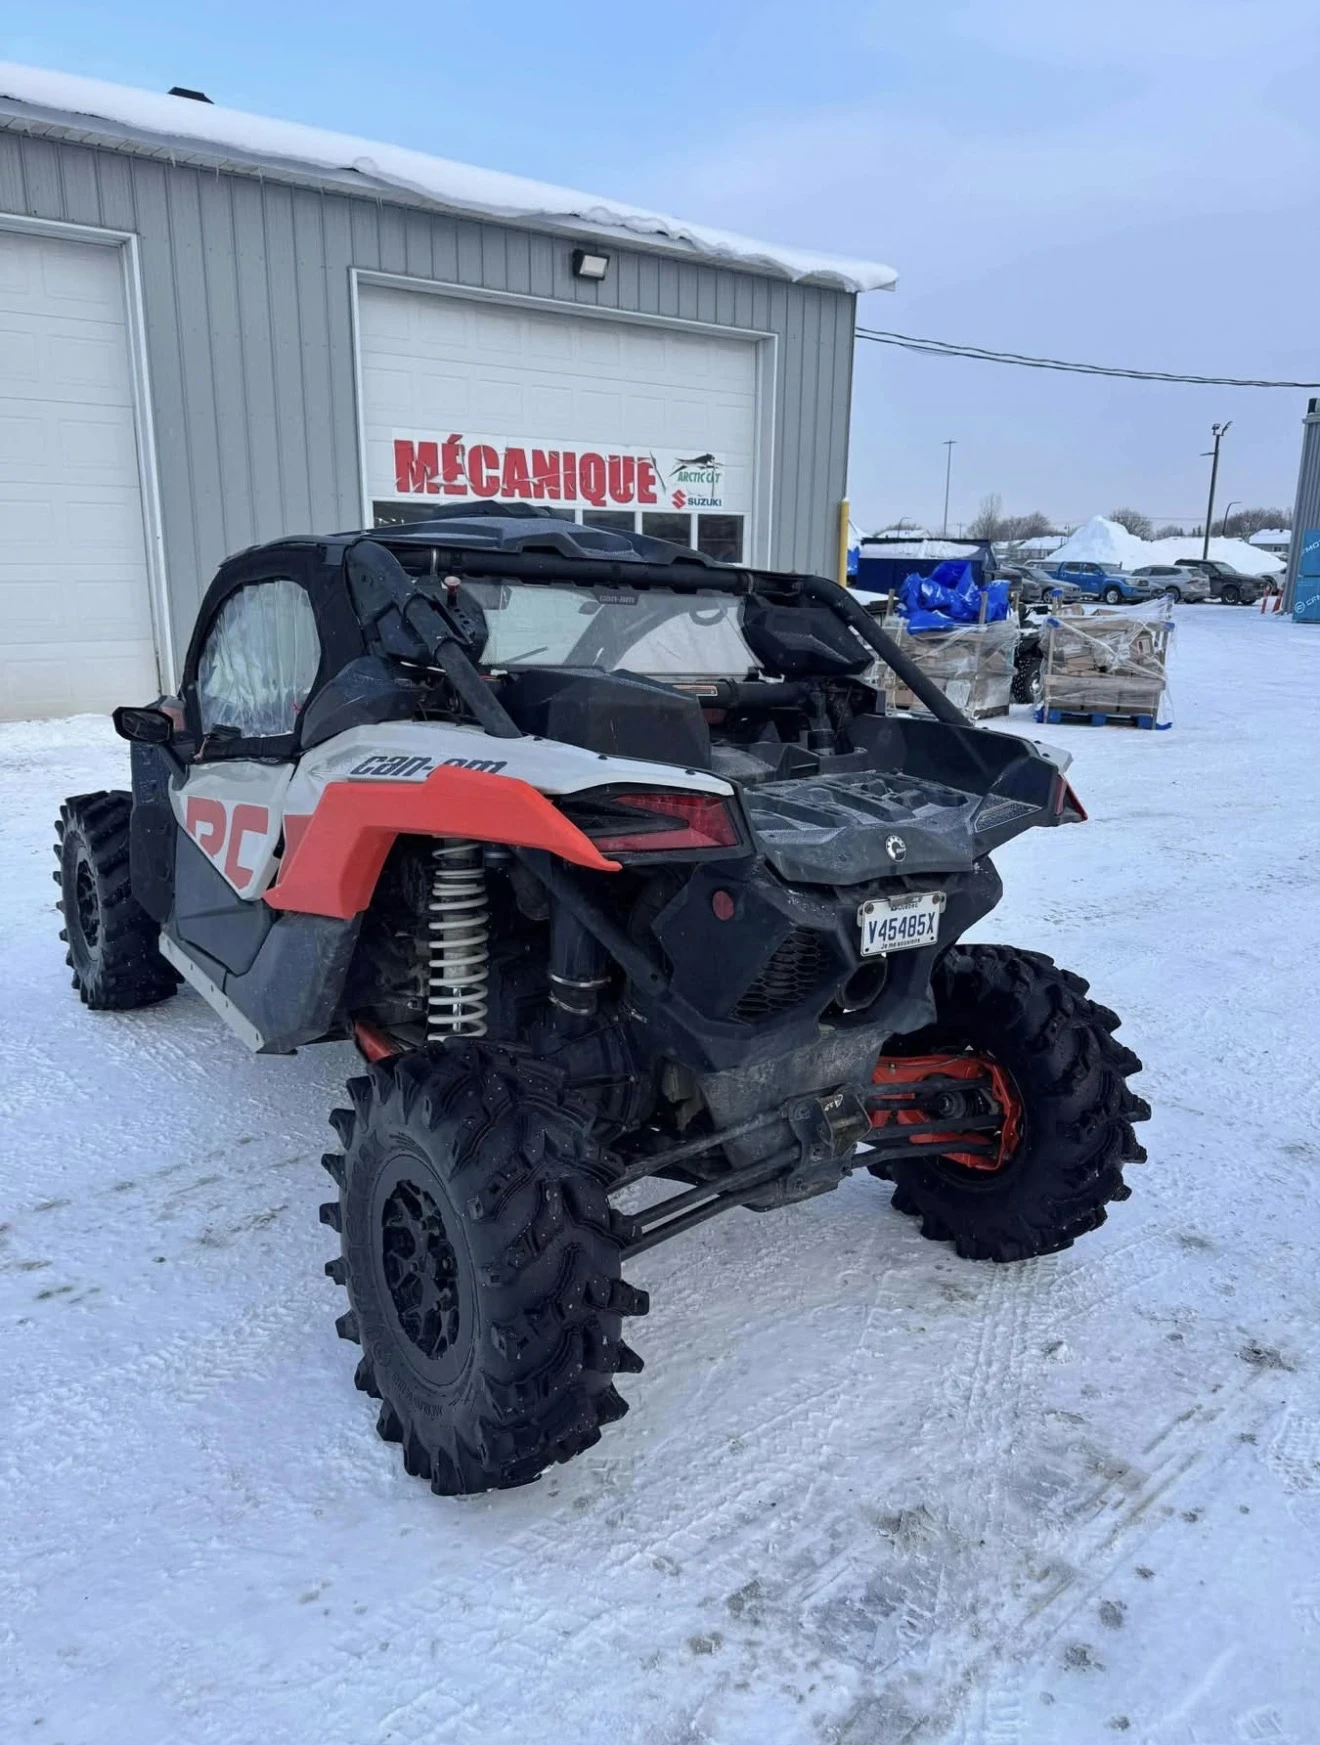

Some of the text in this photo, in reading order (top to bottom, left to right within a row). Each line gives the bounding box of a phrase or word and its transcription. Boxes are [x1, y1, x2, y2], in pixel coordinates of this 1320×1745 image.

[394, 434, 657, 506] MÉCANIQUE
[677, 471, 706, 483] ARCTIC
[687, 497, 722, 506] SUZUKI
[869, 912, 935, 944] V45485X
